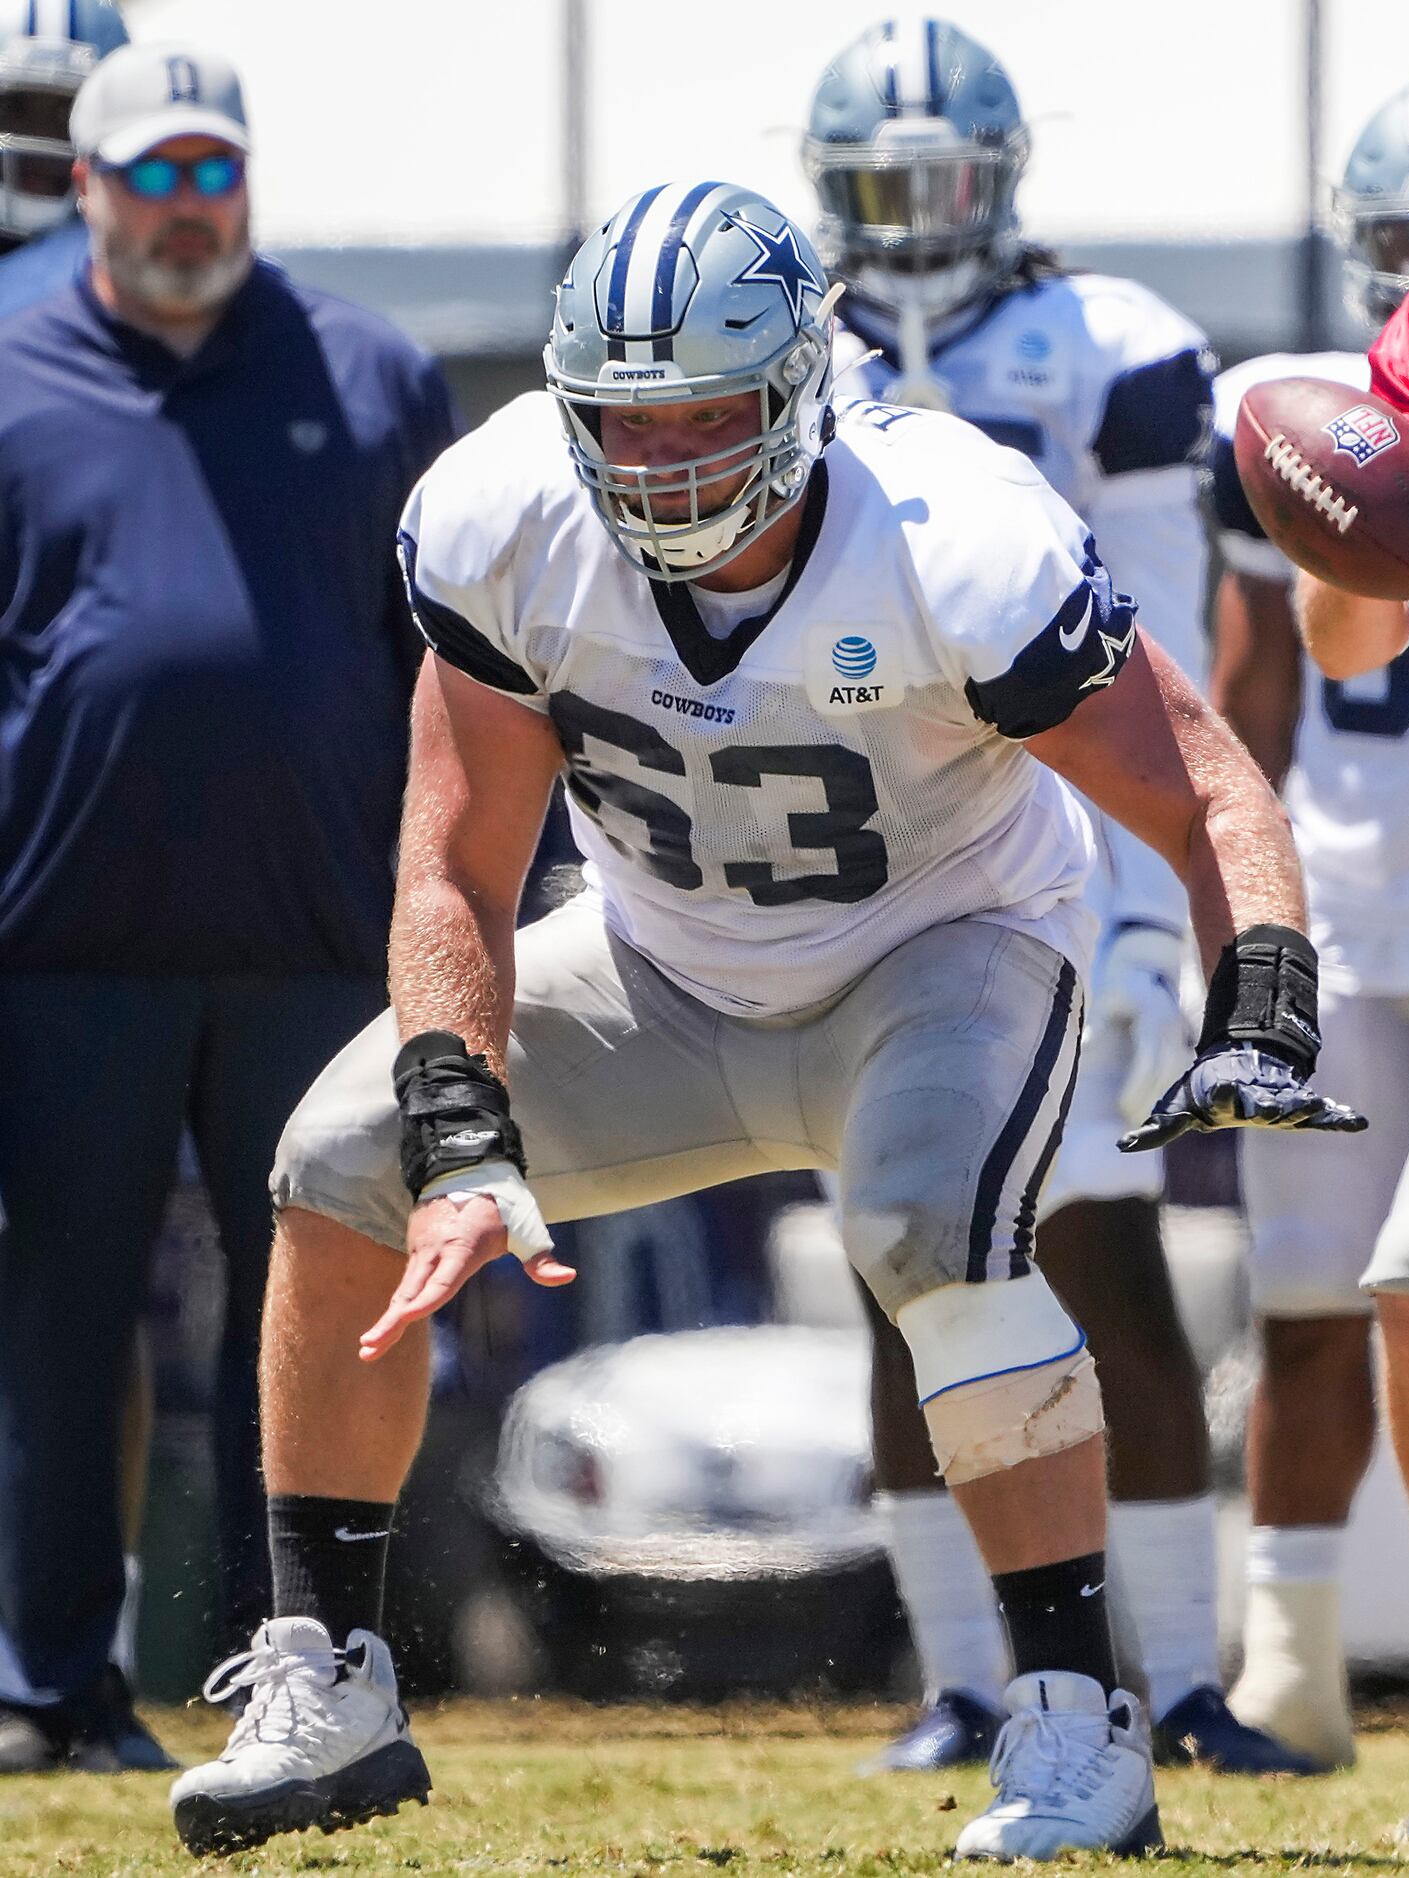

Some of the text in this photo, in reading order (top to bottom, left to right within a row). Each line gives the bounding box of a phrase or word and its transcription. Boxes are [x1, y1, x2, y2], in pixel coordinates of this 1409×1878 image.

[612, 369, 665, 381] COWBOYS
[1352, 409, 1394, 447] NFL
[651, 689, 736, 725] COWBOYS
[829, 685, 884, 704] AT&T
[549, 689, 889, 906] 63
